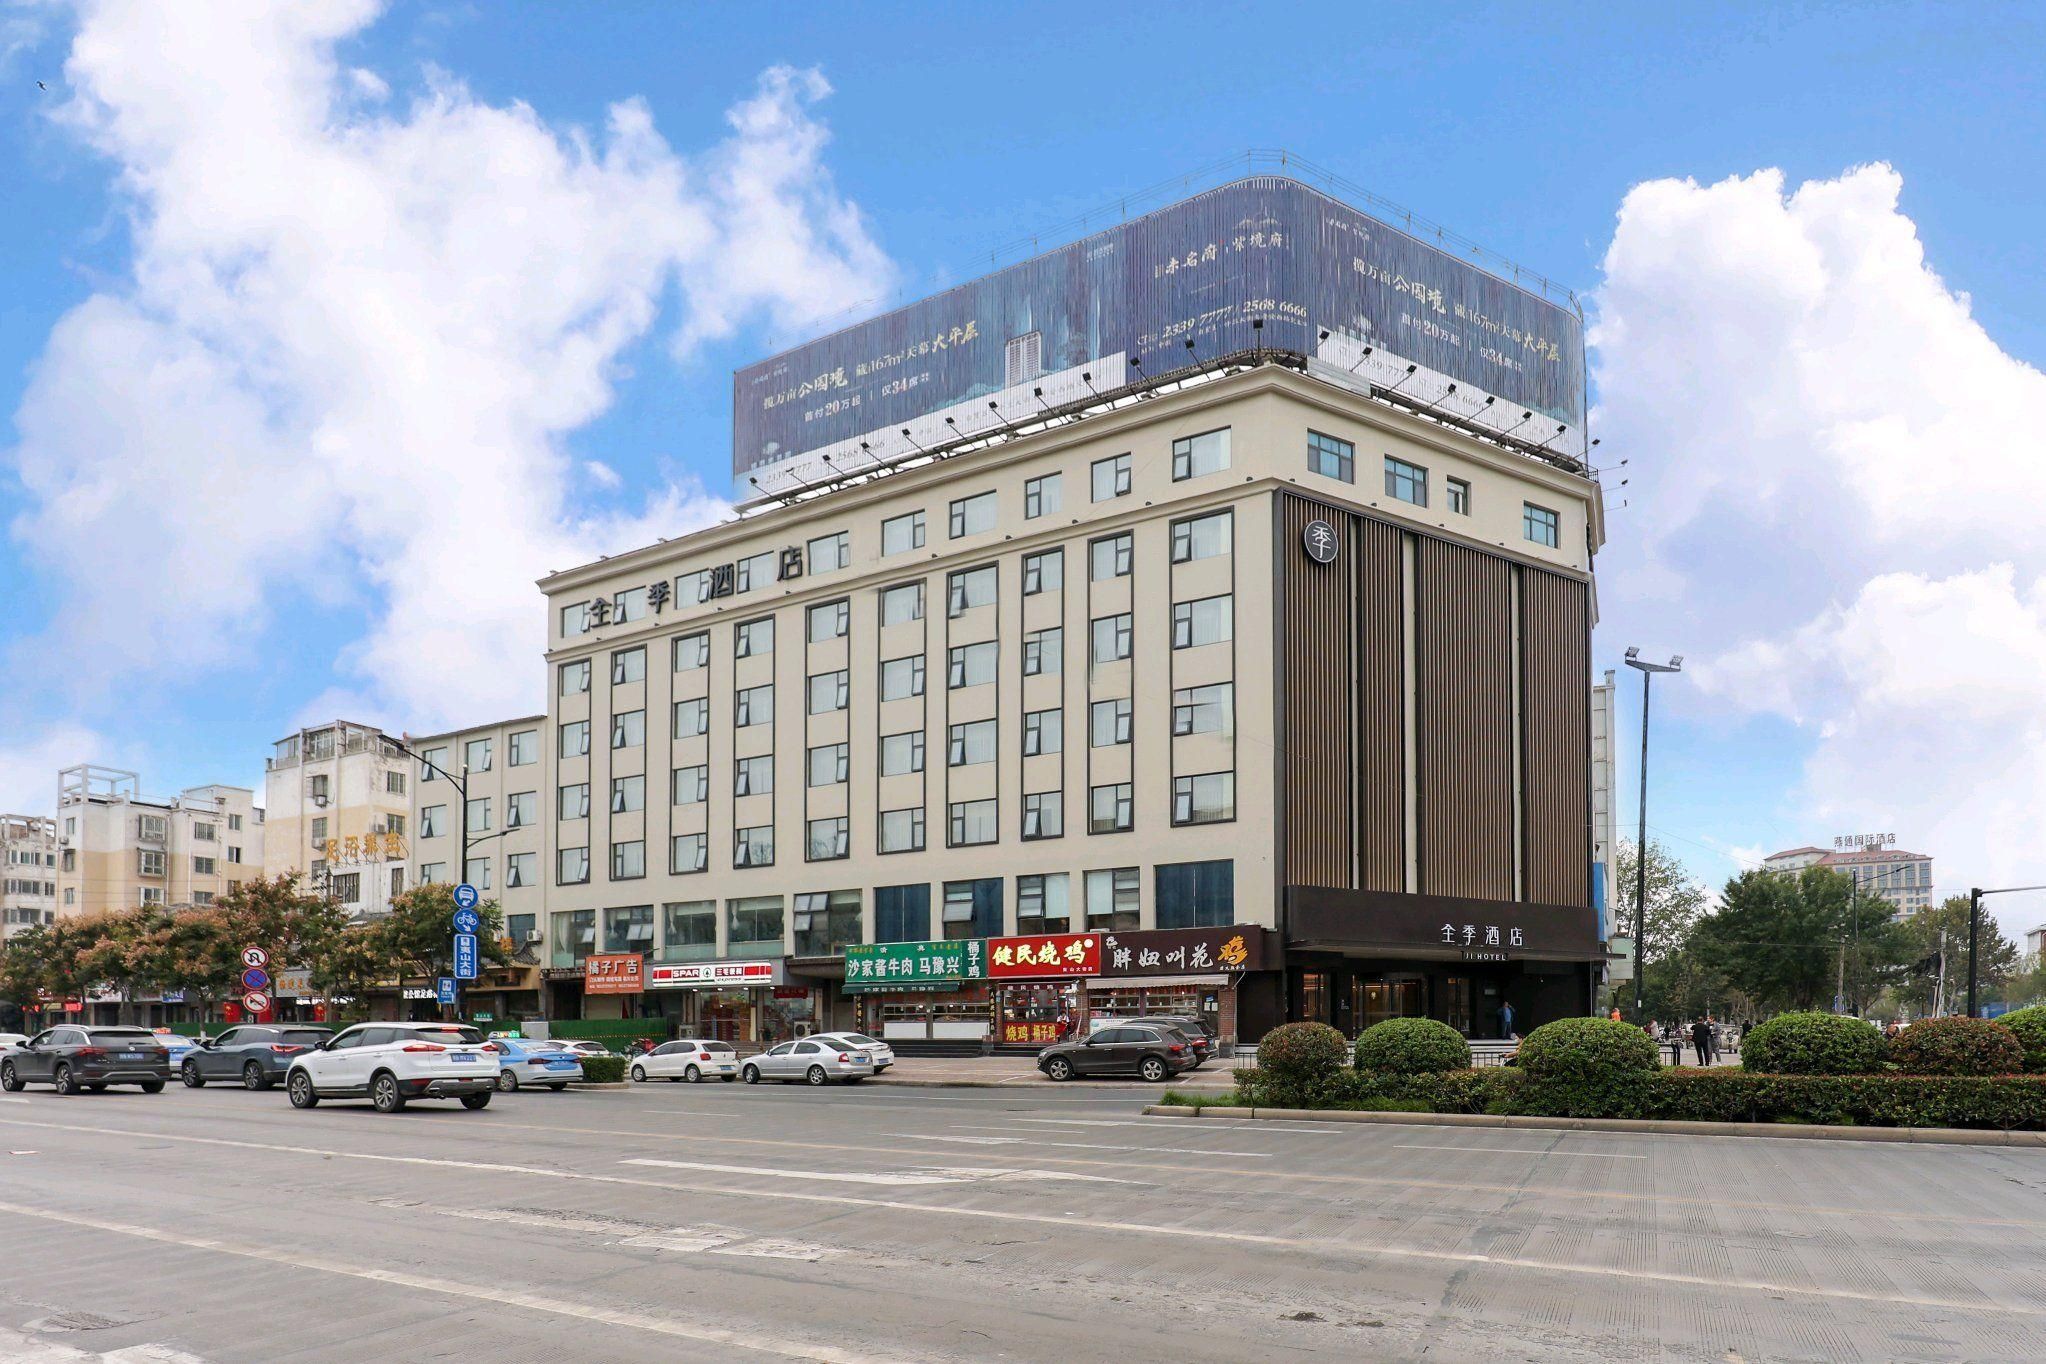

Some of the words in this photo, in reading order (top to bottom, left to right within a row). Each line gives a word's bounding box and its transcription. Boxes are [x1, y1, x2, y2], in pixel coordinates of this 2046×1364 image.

[1164, 312, 1196, 338] 2339
[1200, 303, 1234, 325] 7777
[1279, 300, 1308, 317] 6666
[1311, 525, 1332, 559] 季
[589, 545, 803, 629] 全季酒店
[1441, 923, 1523, 946] 全季酒店
[967, 941, 980, 977] 桶子鸡
[992, 940, 1085, 966] 健民烧鸡
[1477, 953, 1506, 961] HOTEL
[589, 959, 638, 975] 橘子广告
[673, 968, 700, 978] SPAR
[848, 957, 913, 977] 沙家酱牛肉
[919, 956, 960, 975] 马豫兴
[1006, 1024, 1028, 1041] 烧鸡
